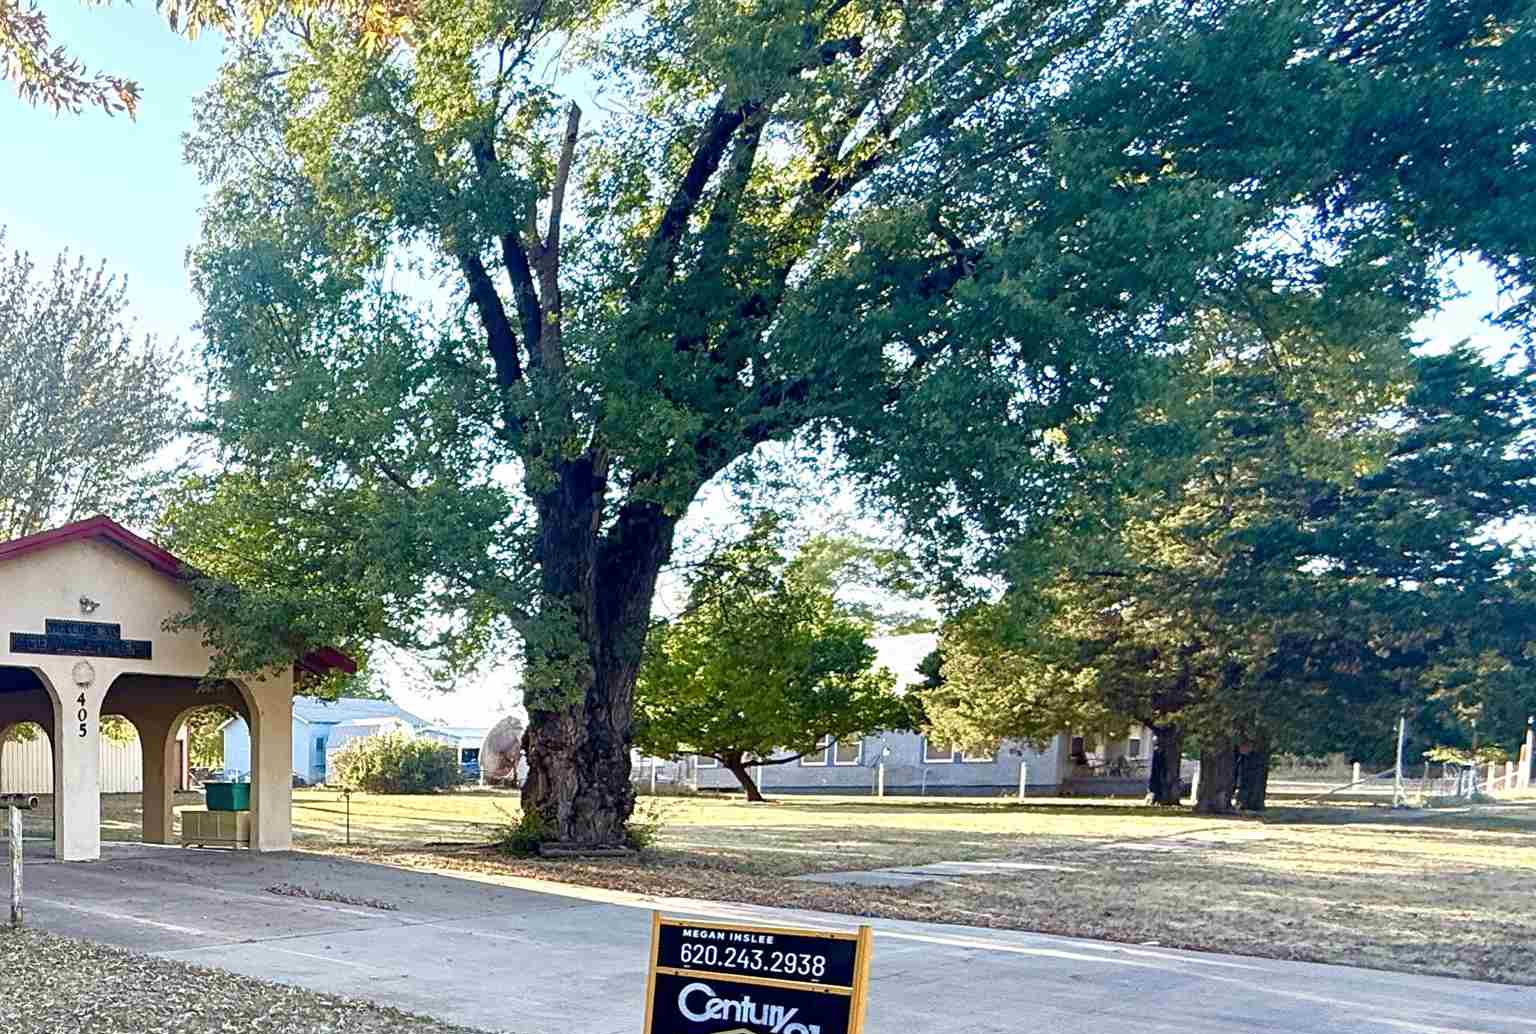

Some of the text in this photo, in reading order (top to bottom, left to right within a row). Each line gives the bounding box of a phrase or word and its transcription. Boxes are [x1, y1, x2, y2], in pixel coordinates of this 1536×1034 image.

[76, 692, 88, 738] 405
[682, 929, 774, 944] MEGAN INSLEE
[680, 943, 826, 977] 620.243.2938
[677, 982, 800, 1034] Century
